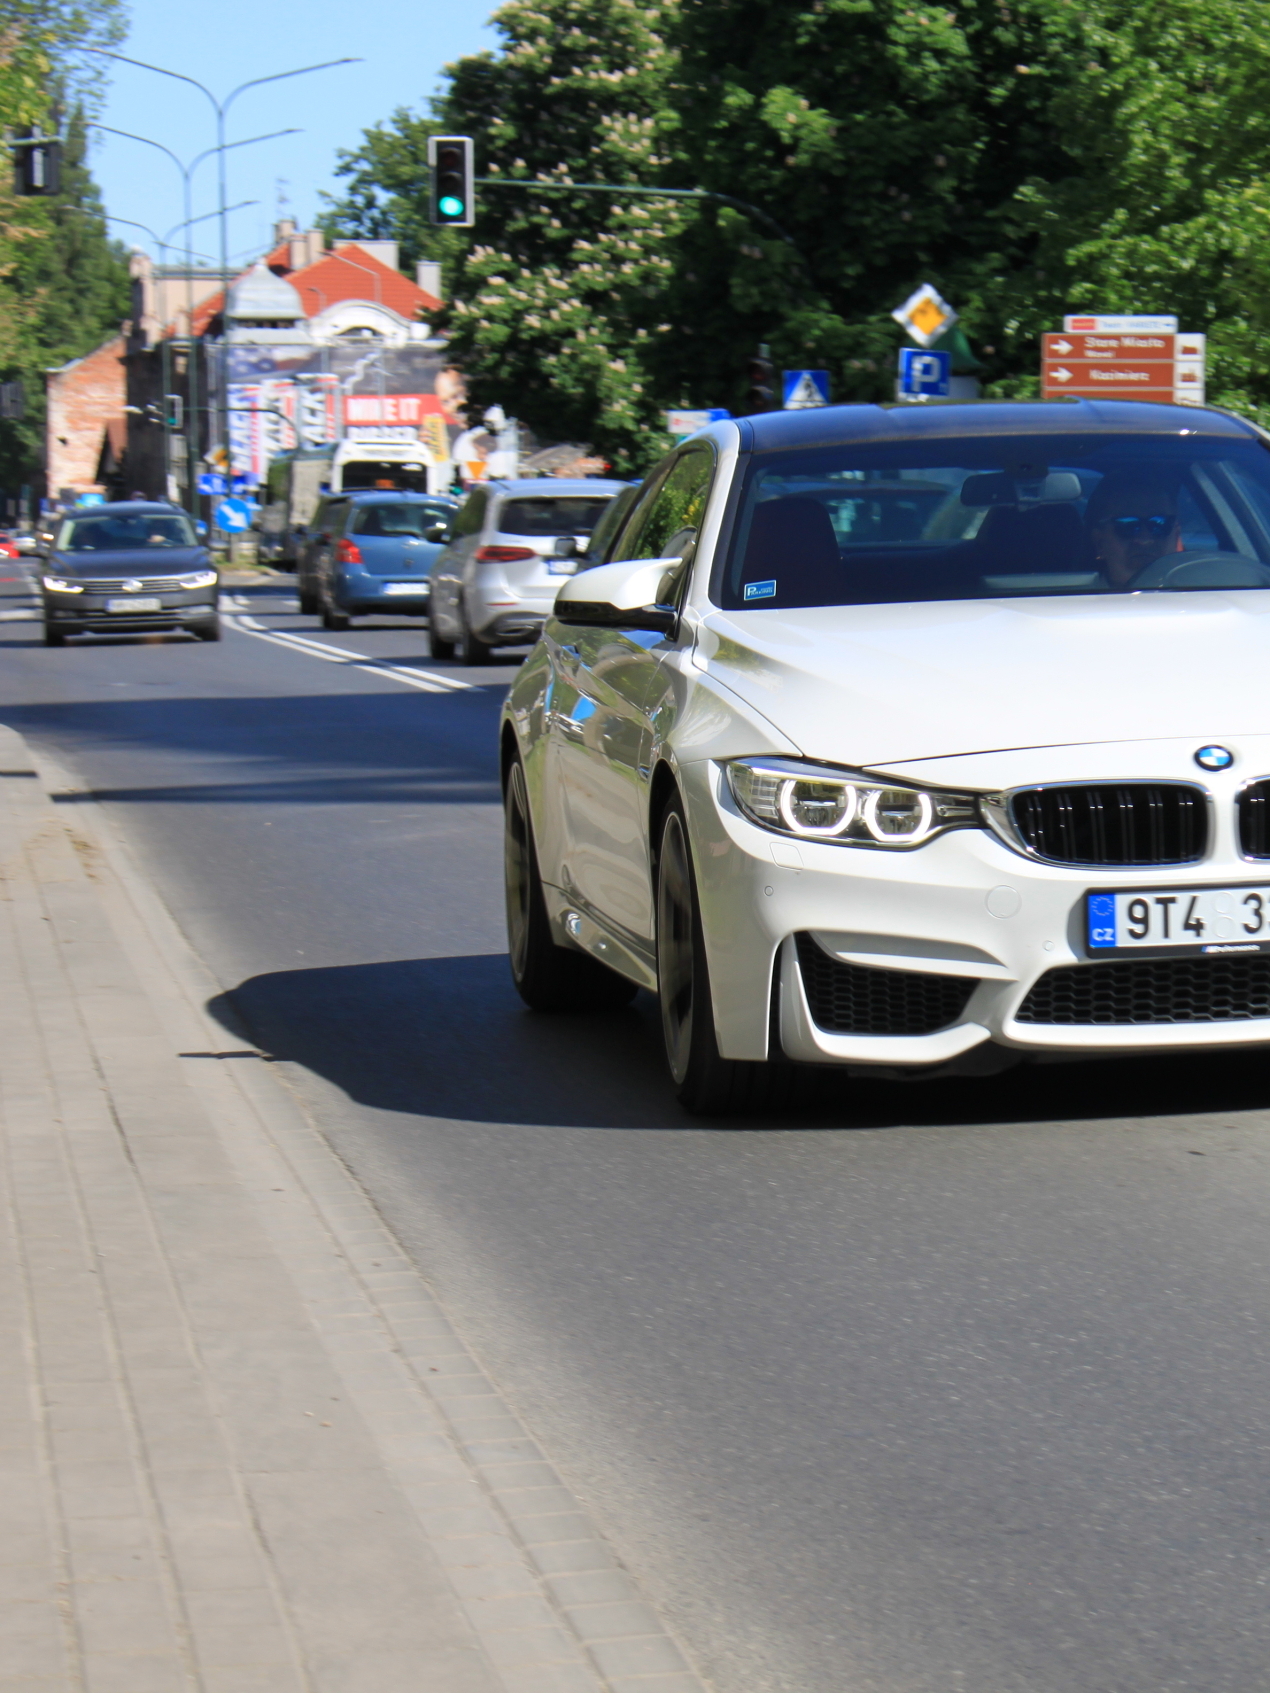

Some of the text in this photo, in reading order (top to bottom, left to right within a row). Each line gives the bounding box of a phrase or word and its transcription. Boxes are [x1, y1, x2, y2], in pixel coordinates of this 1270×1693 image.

[1121, 336, 1166, 348] Miasto
[911, 355, 941, 392] P
[1089, 369, 1150, 381] Kazimierz
[1127, 895, 1205, 940] 9T4
[1092, 928, 1115, 942] CZ
